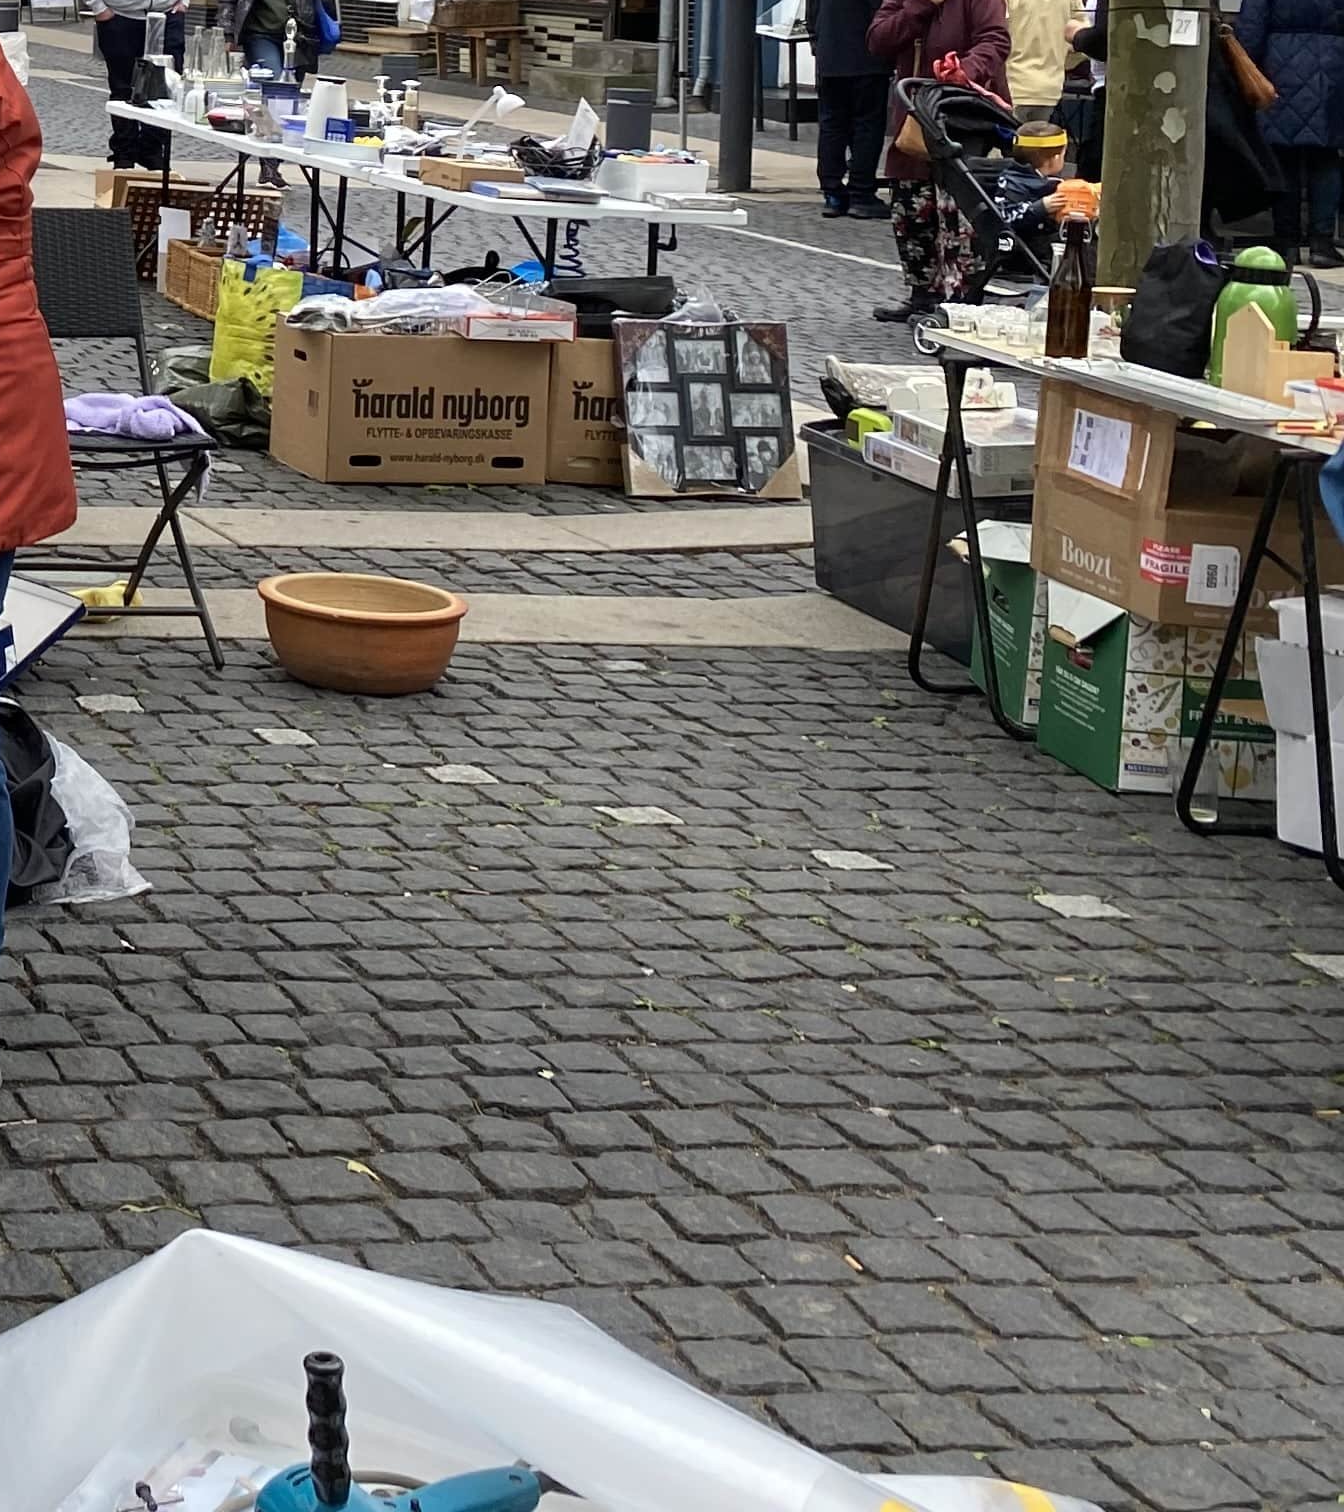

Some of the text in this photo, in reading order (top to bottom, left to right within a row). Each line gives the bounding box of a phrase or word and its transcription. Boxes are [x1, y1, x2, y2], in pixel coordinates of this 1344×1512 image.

[1175, 18, 1193, 34] 27
[352, 387, 530, 428] harald nyborg
[366, 427, 405, 440] FLYTTE-
[414, 427, 513, 440] OPBEVARINGSKASSE
[1061, 534, 1115, 581] Boozt
[1145, 558, 1190, 576] FRAGILE
